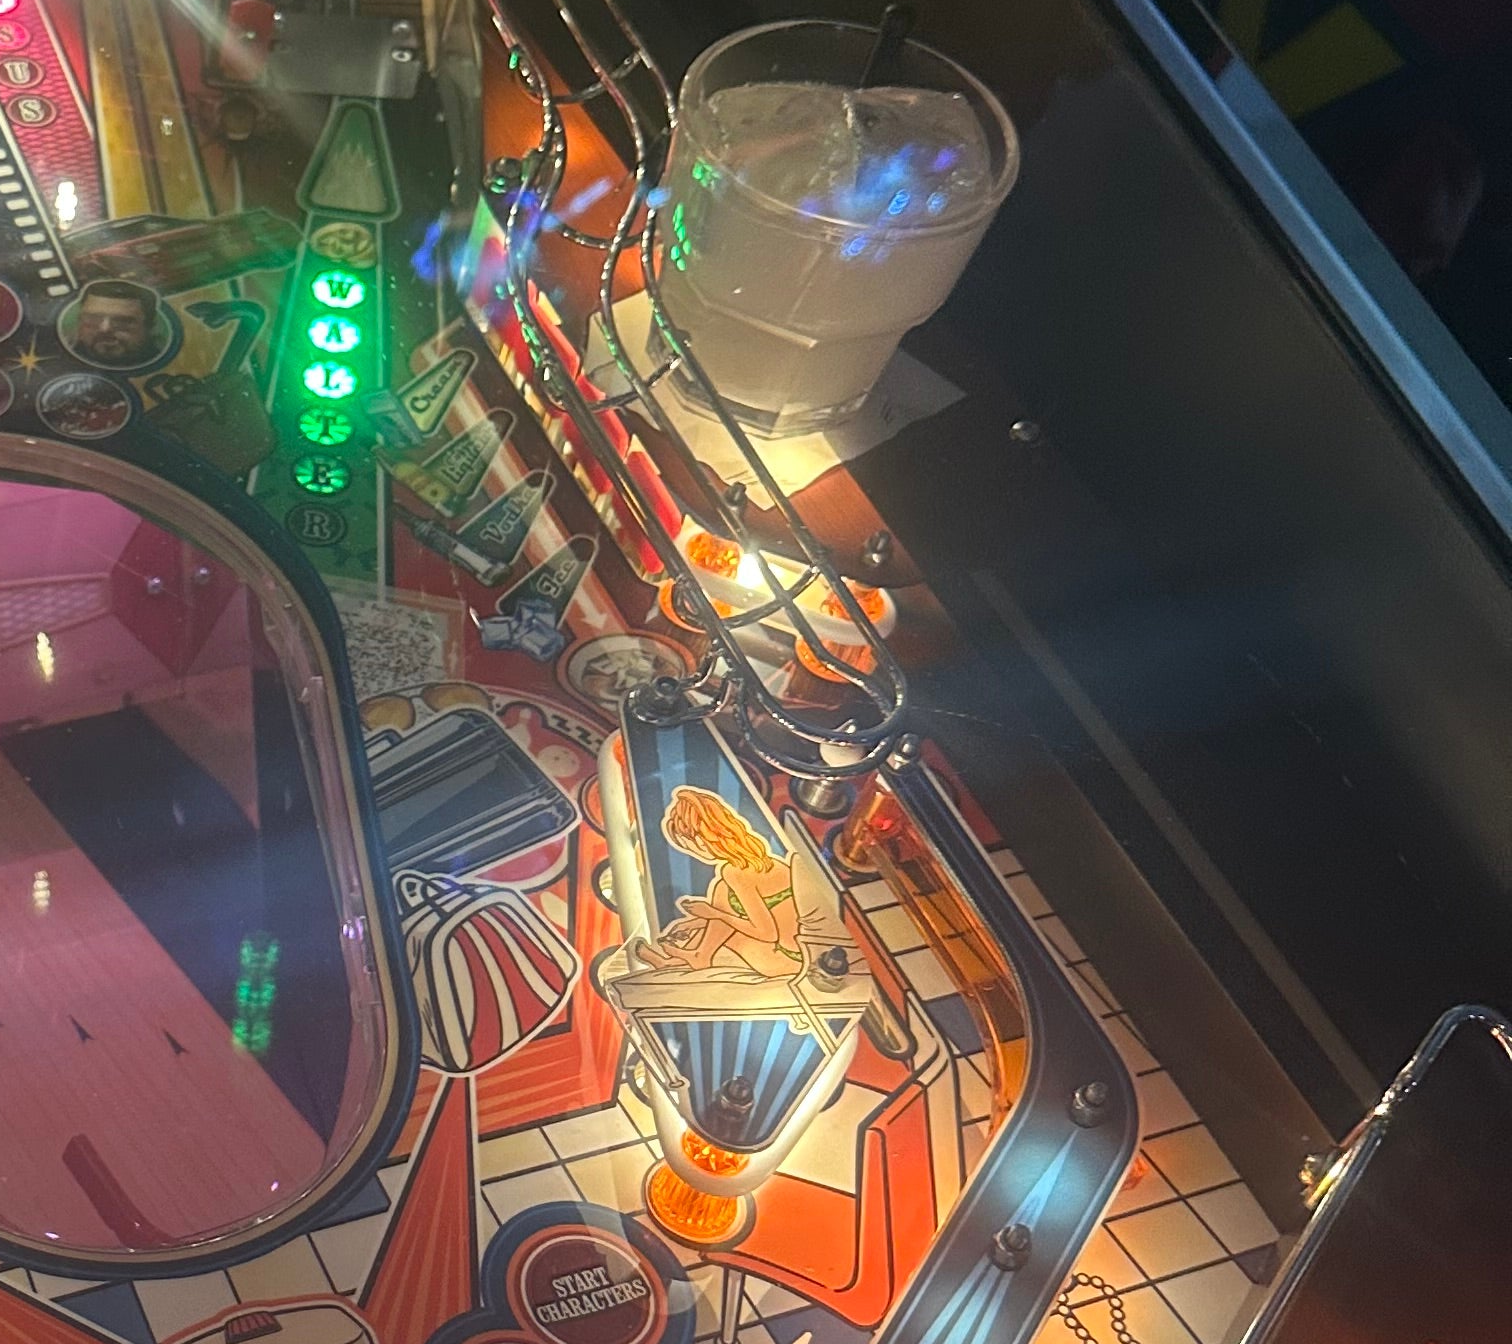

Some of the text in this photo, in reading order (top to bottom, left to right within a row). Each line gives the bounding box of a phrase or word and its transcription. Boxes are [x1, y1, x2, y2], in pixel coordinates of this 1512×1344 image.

[480, 483, 538, 544] Vodka
[538, 558, 577, 598] Ice
[536, 1279, 648, 1324] CHARACTERS
[552, 1266, 610, 1299] START
